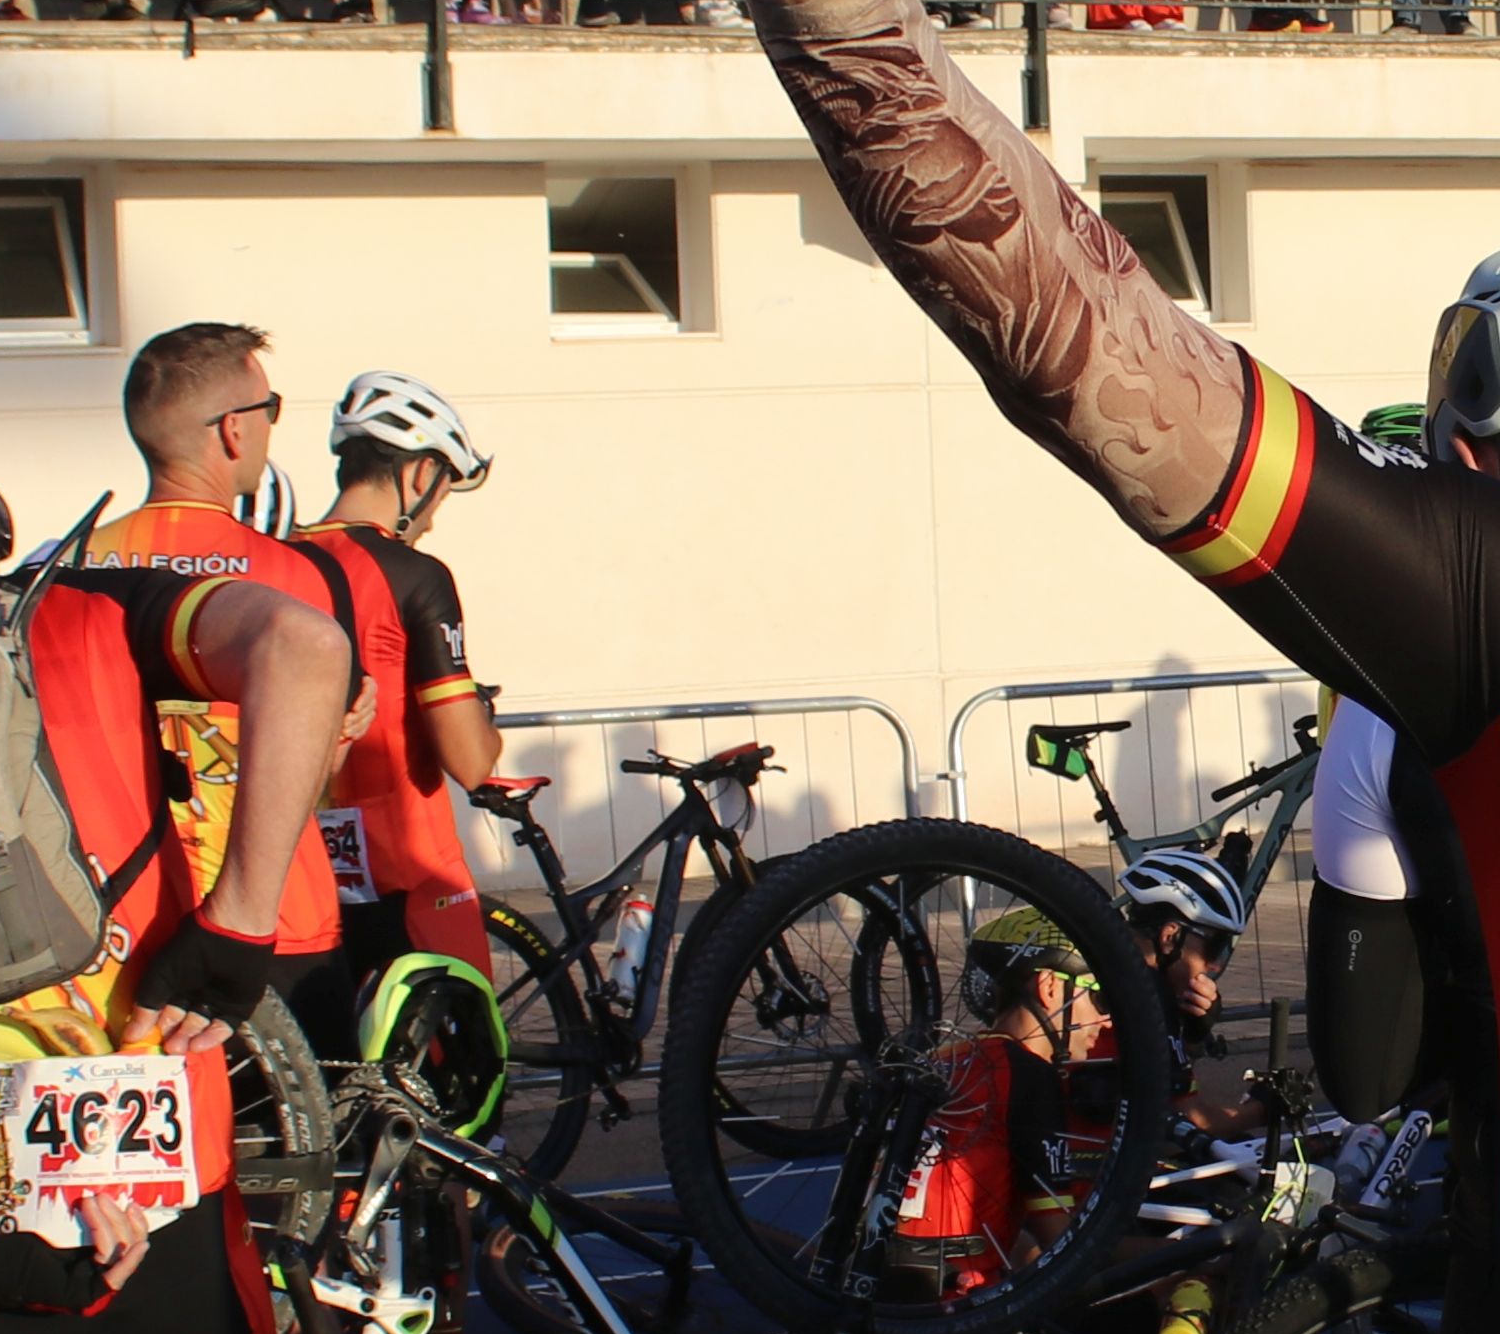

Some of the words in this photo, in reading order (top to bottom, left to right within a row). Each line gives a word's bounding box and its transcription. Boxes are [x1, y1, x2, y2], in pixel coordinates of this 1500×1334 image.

[85, 553, 123, 569] LA
[131, 554, 249, 575] LEGIÓN
[25, 1088, 183, 1156] 4623
[1374, 1116, 1430, 1199] ORBEA
